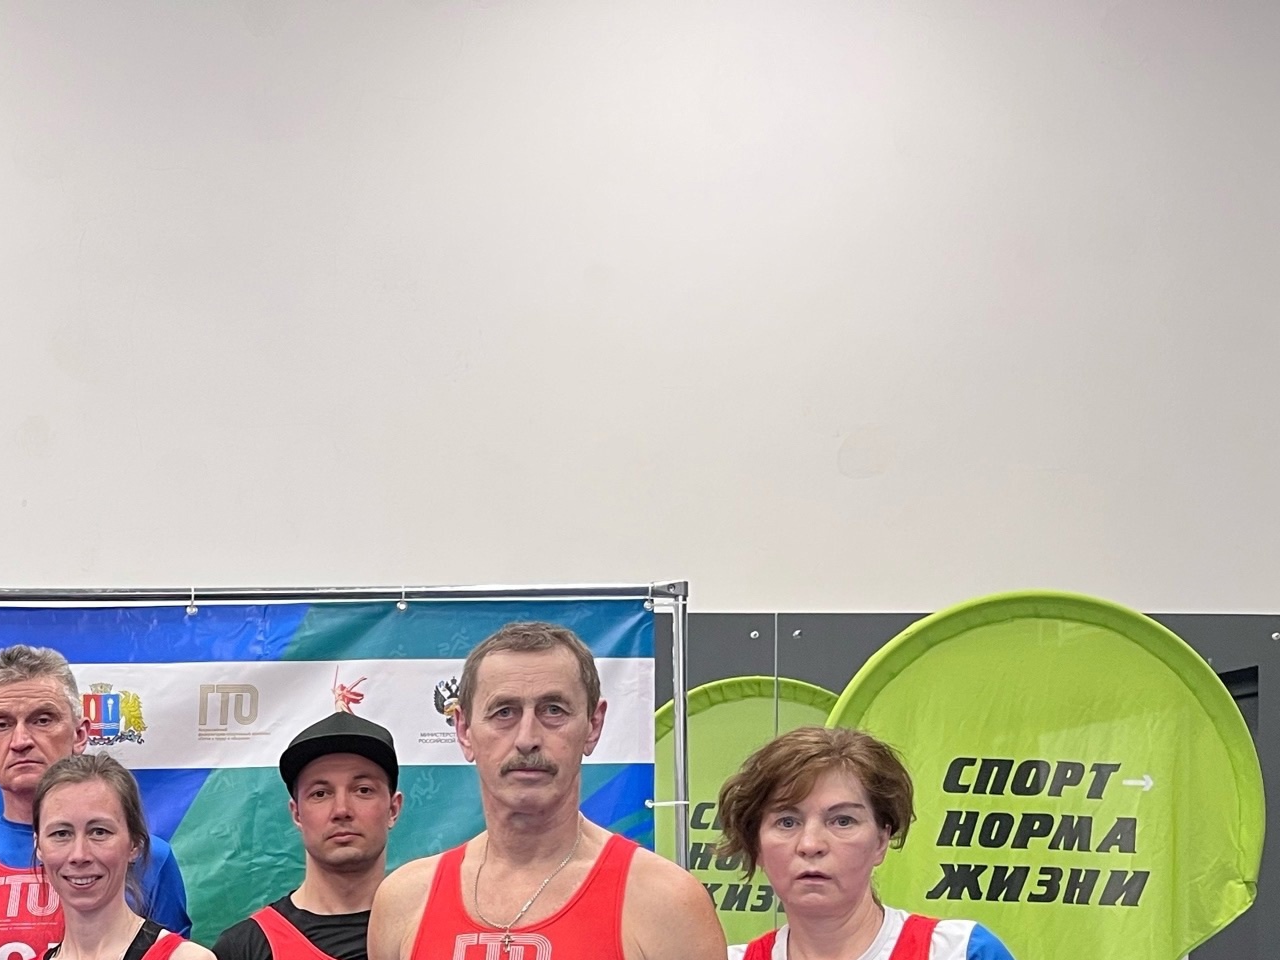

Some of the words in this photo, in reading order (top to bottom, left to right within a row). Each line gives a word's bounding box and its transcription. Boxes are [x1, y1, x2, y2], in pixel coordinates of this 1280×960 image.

[199, 684, 258, 725] ГТО
[943, 757, 1121, 800] СПОРТ
[936, 811, 1137, 854] НОРМА
[925, 863, 1150, 907] ЖИЗНИ
